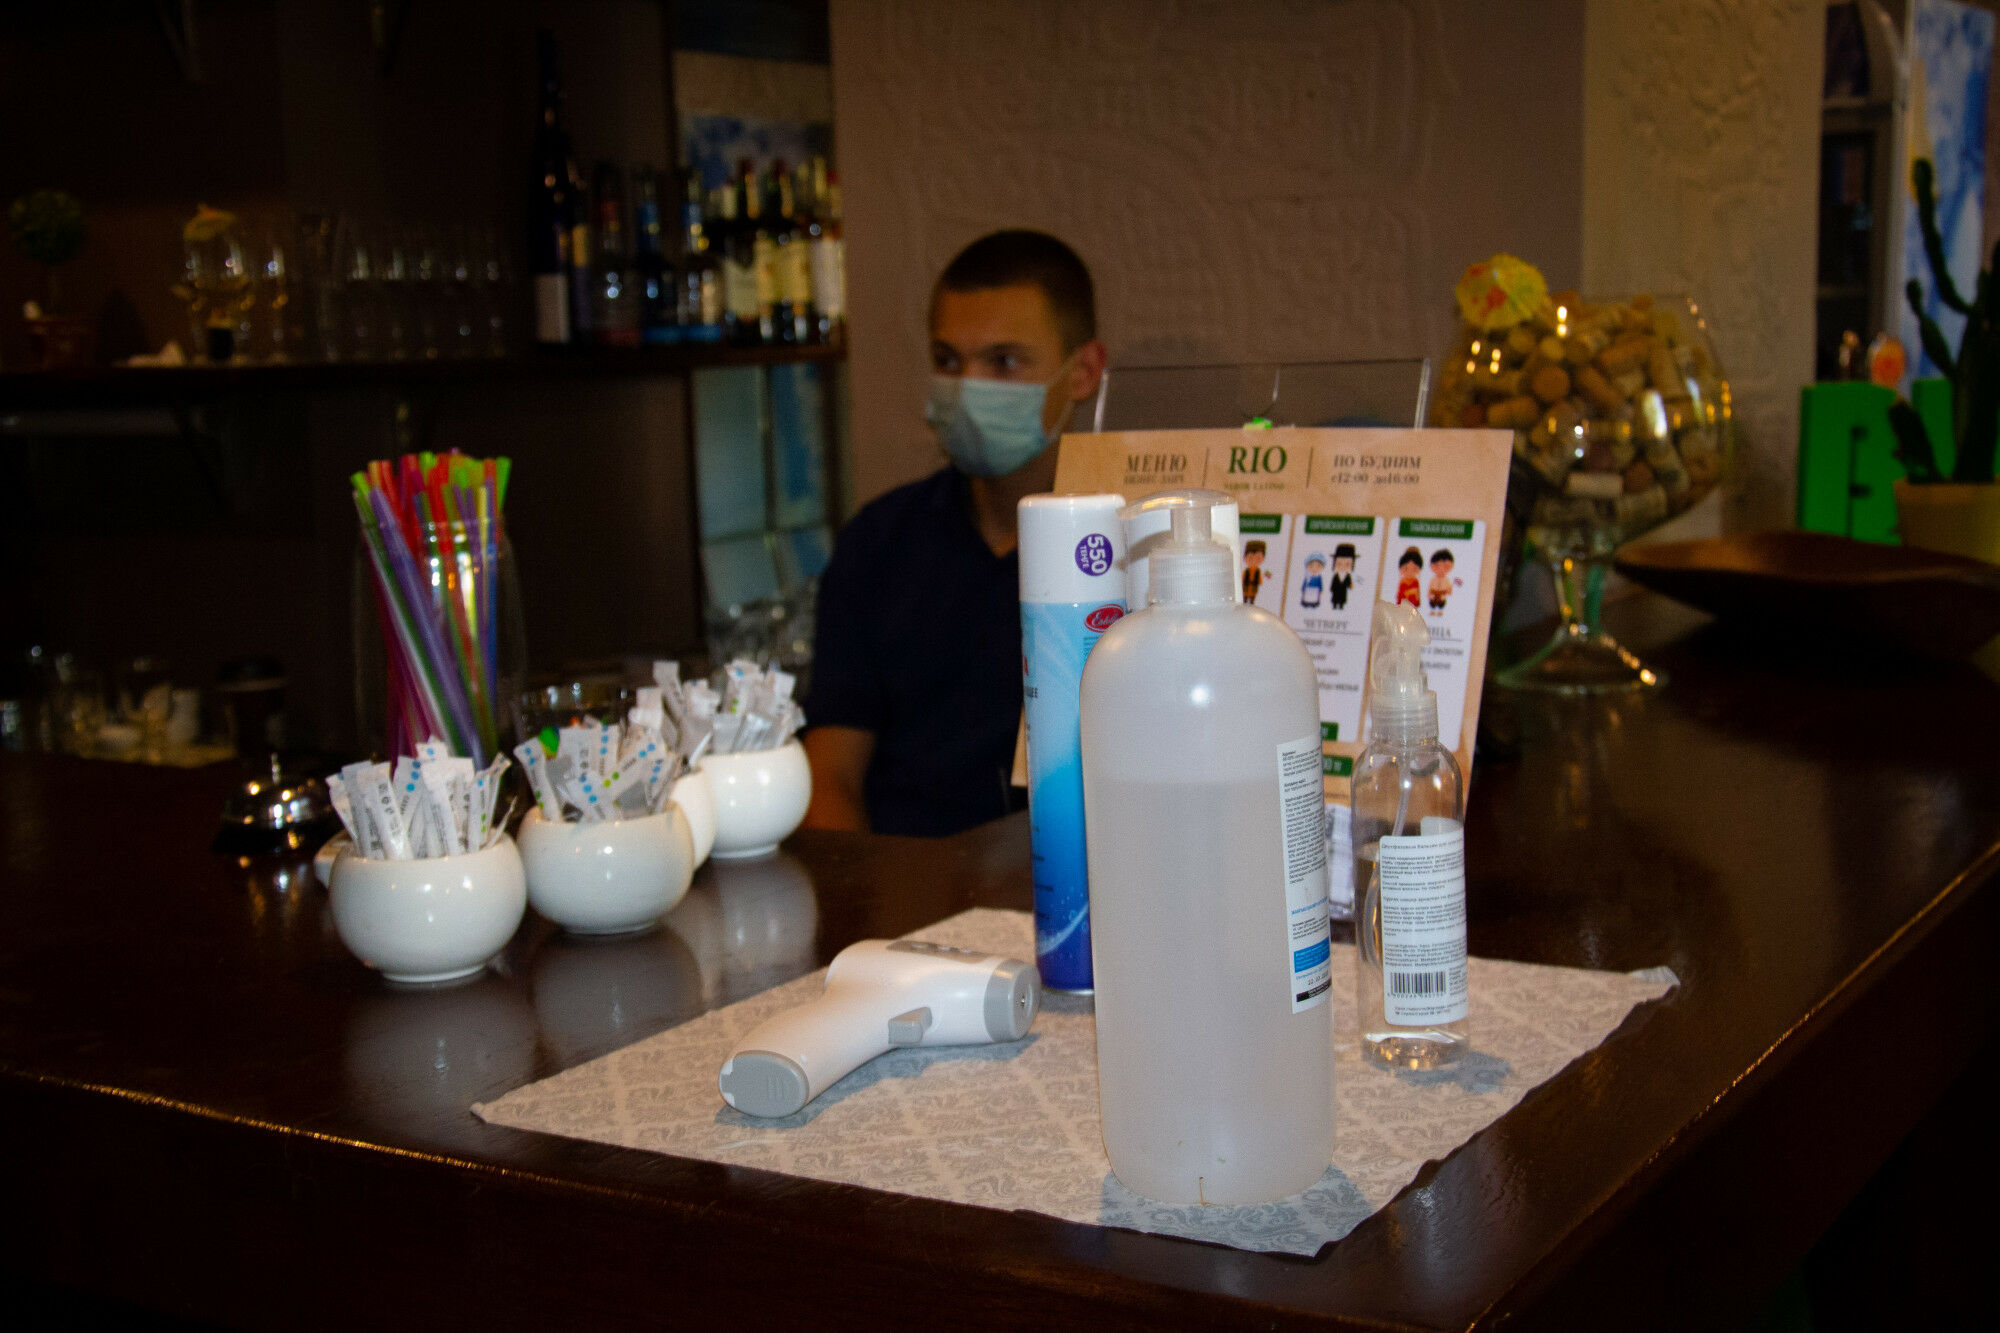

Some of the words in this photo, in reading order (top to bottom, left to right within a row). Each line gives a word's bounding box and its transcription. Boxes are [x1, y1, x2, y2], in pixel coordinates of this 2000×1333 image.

[1126, 454, 1187, 473] МЕНЮ
[1228, 445, 1288, 474] RIO
[1333, 455, 1355, 468] ПО
[1359, 455, 1421, 469] БУДНЯМ
[1087, 536, 1108, 574] 550
